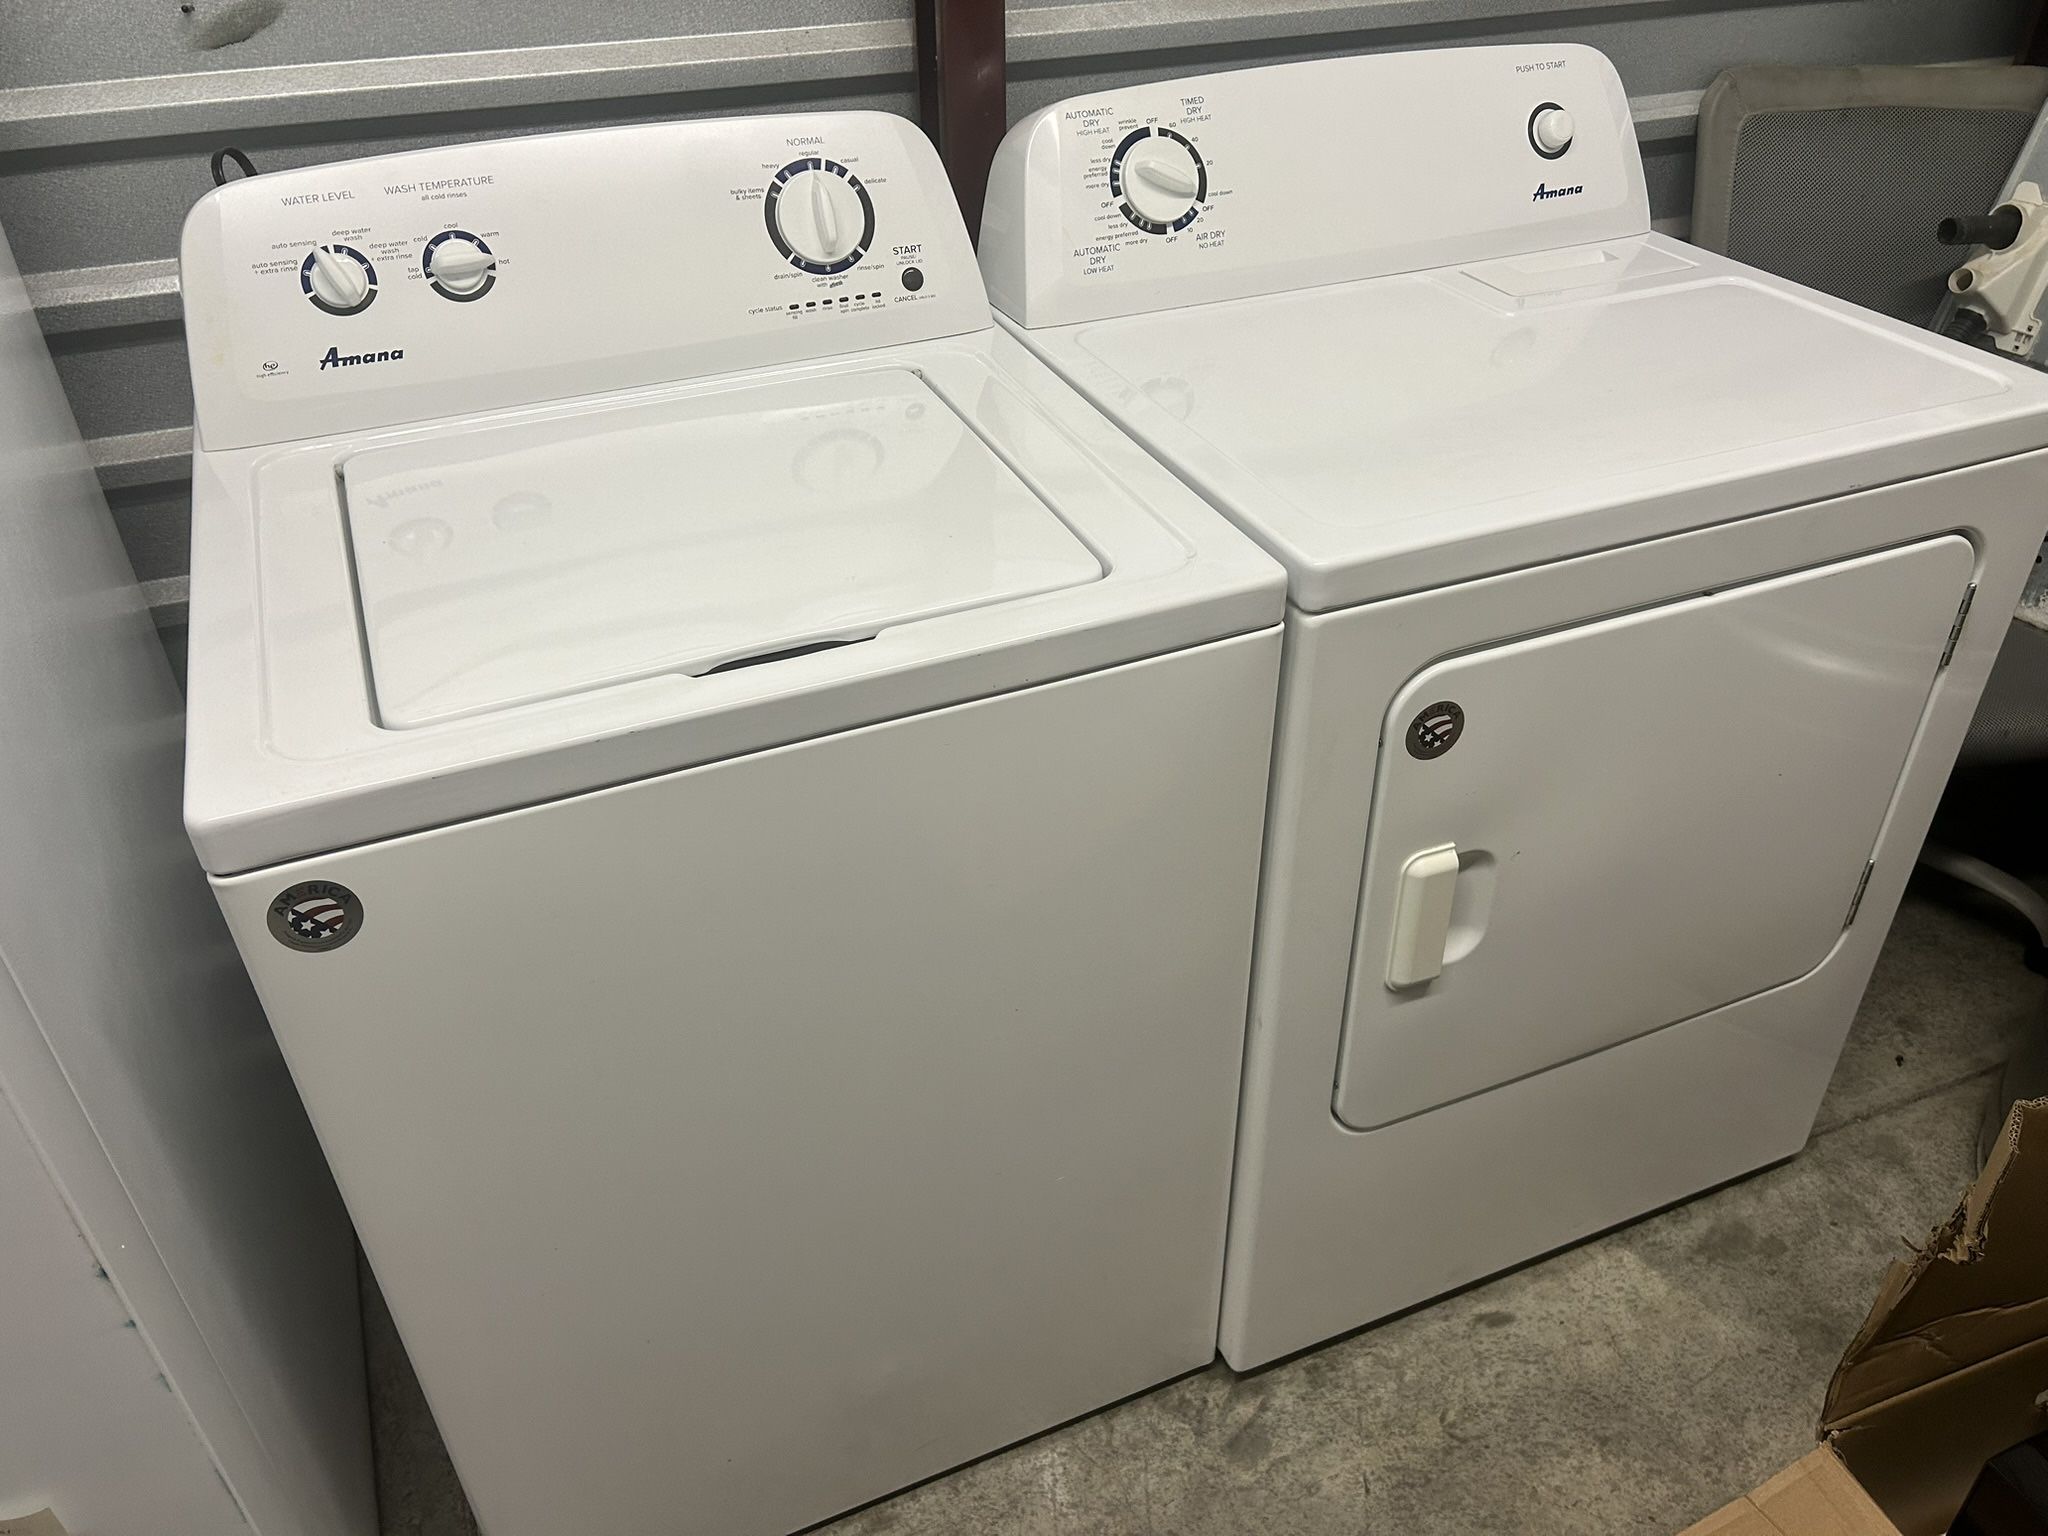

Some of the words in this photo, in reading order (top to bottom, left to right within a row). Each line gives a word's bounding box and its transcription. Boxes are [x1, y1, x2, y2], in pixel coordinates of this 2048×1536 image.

[1516, 65, 1534, 73] PUSH
[1536, 63, 1545, 71] TO
[1546, 61, 1566, 69] START
[1181, 96, 1204, 106] TIMED
[1065, 108, 1114, 120] AUTOMATIC
[1186, 106, 1202, 115] DRY
[1083, 119, 1099, 127] DRY
[1197, 114, 1212, 122] HEAT
[1119, 123, 1138, 131] prevent
[786, 136, 824, 147] NORMAL
[1083, 171, 1108, 179] preferred
[384, 183, 416, 195] WASH
[419, 175, 494, 191] TEMPERATURE
[731, 188, 747, 196] bulky
[1533, 183, 1583, 202] Amana
[281, 193, 319, 206] WATER
[322, 190, 355, 203] LEVEL
[351, 227, 371, 235] water
[1096, 234, 1114, 242] energy
[1115, 230, 1138, 239] preferred
[1196, 233, 1208, 241] AIR
[1210, 230, 1225, 239] DRY
[291, 239, 317, 249] sensing
[369, 242, 388, 250] deep
[893, 245, 922, 255] START
[1074, 243, 1120, 257] AUTOMATIC
[270, 259, 298, 268] sensing
[1090, 256, 1106, 265] DRY
[260, 267, 279, 275] extra
[1099, 265, 1114, 273] HEAT
[774, 272, 803, 280] drain/spin
[894, 294, 917, 303] CANCEL
[320, 347, 404, 370] Amana
[1413, 704, 1460, 730] AMERICA
[274, 884, 351, 917] AMERICA
